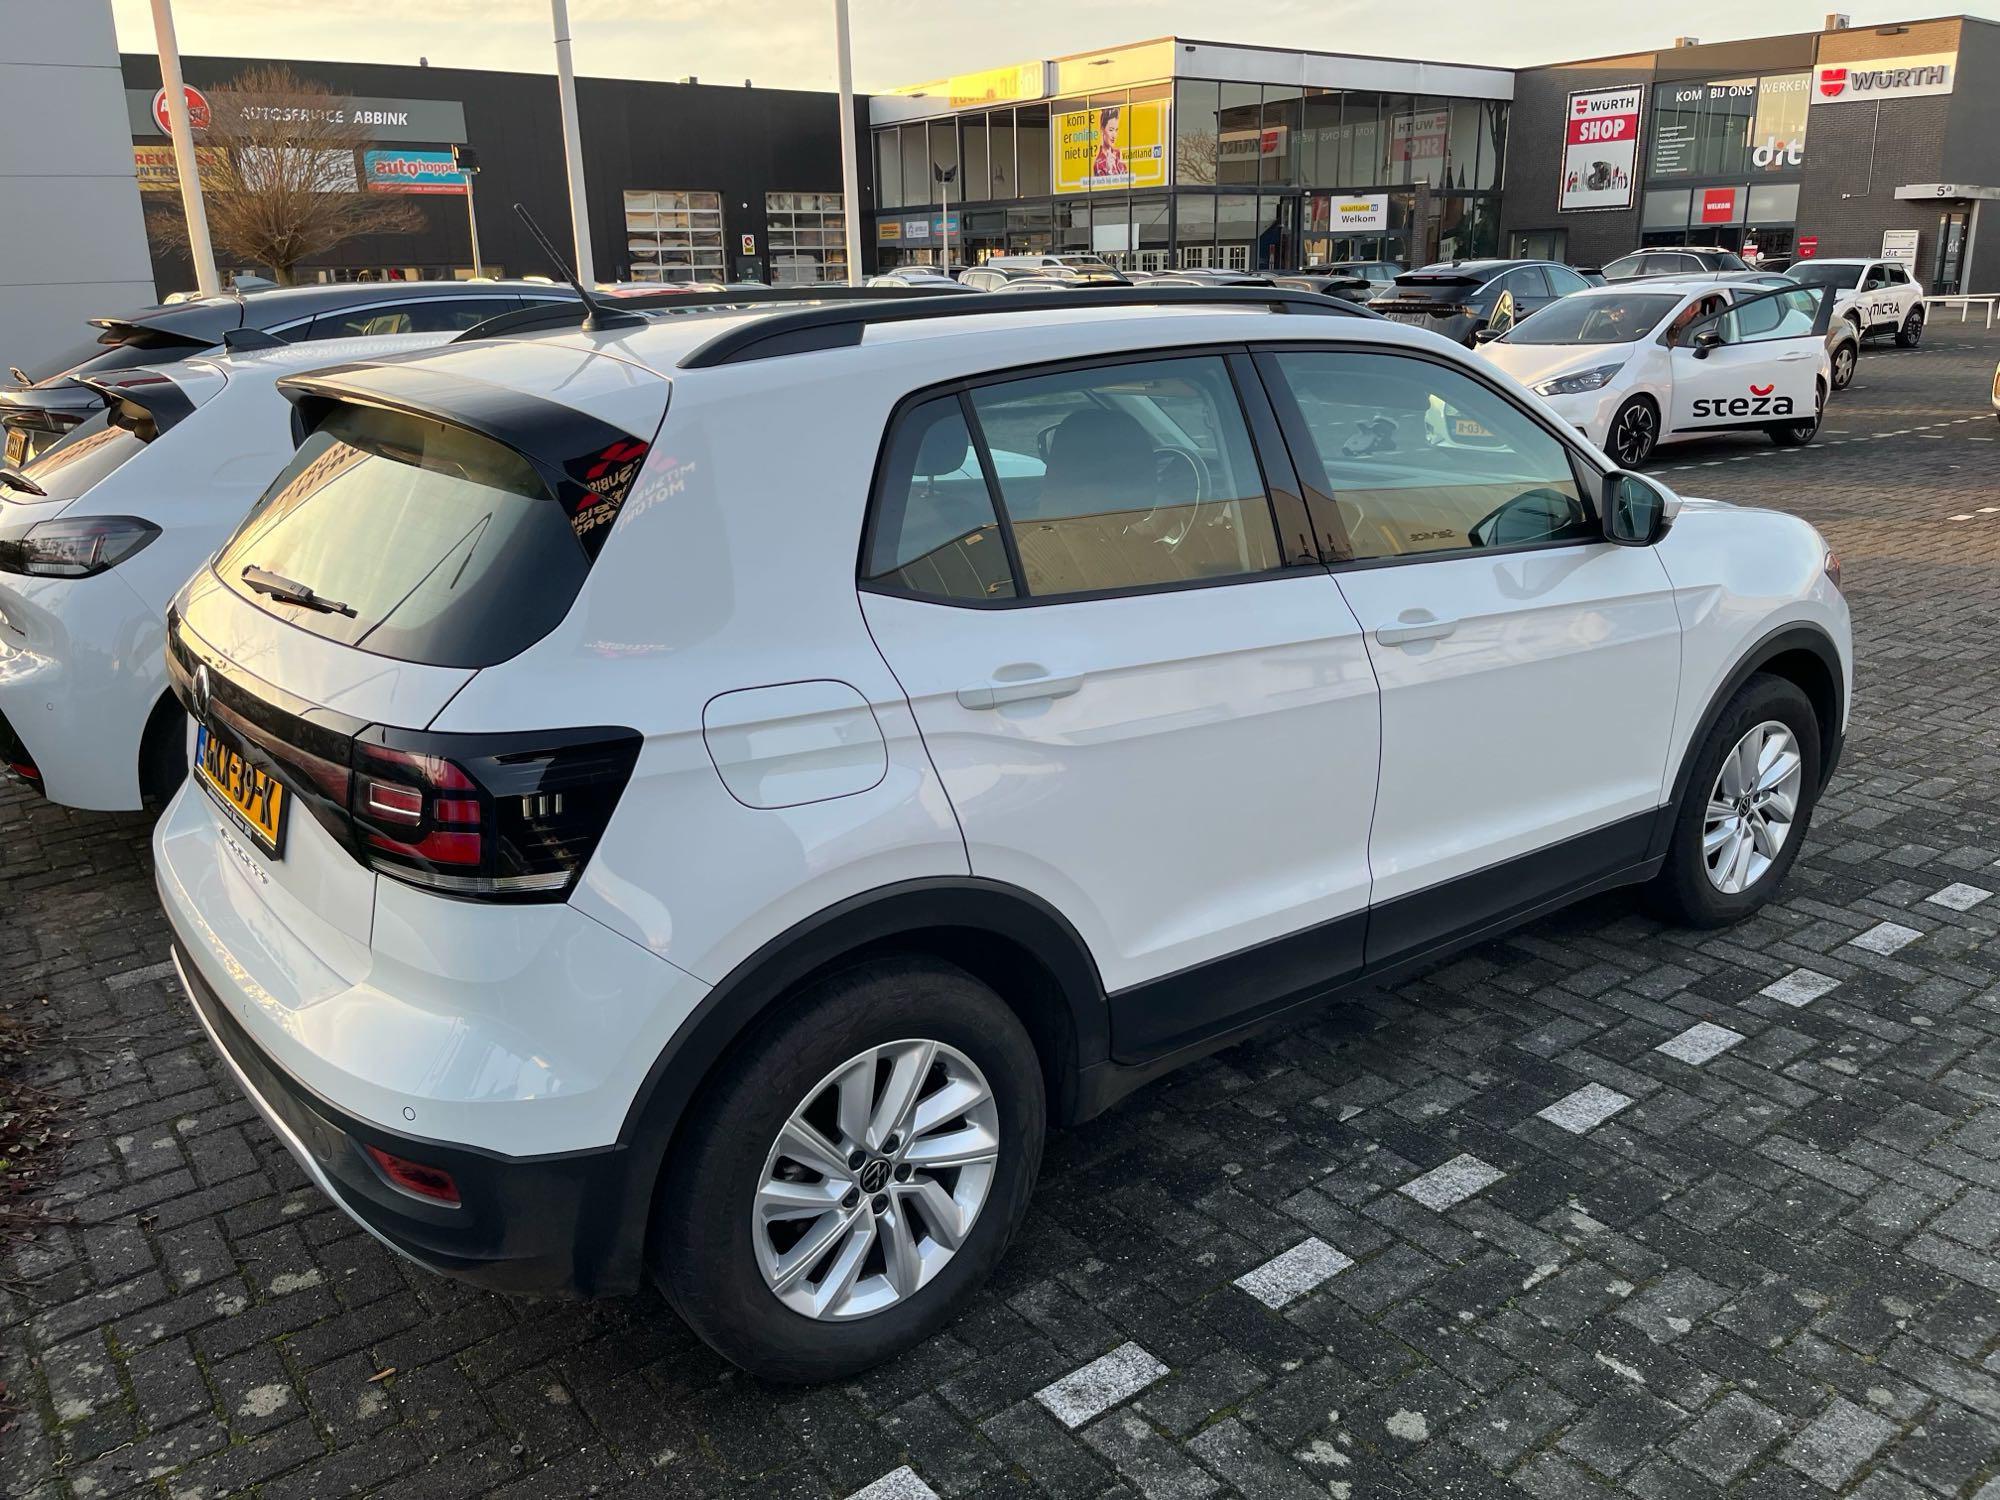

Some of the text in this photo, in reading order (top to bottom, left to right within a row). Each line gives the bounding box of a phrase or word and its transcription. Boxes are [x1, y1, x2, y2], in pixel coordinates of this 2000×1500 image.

[1851, 65, 1945, 91] WÜRTH
[1676, 79, 1810, 102] KOM BIJ ONS WERKEN
[1590, 97, 1635, 112] WÜRTH
[353, 110, 408, 125] ABBINK
[1067, 114, 1085, 127] kom
[1579, 119, 1625, 141] SHOP
[1063, 133, 1073, 144] er
[1064, 147, 1081, 160] niet
[1752, 136, 1802, 167] dit
[1341, 215, 1376, 223] Welkom
